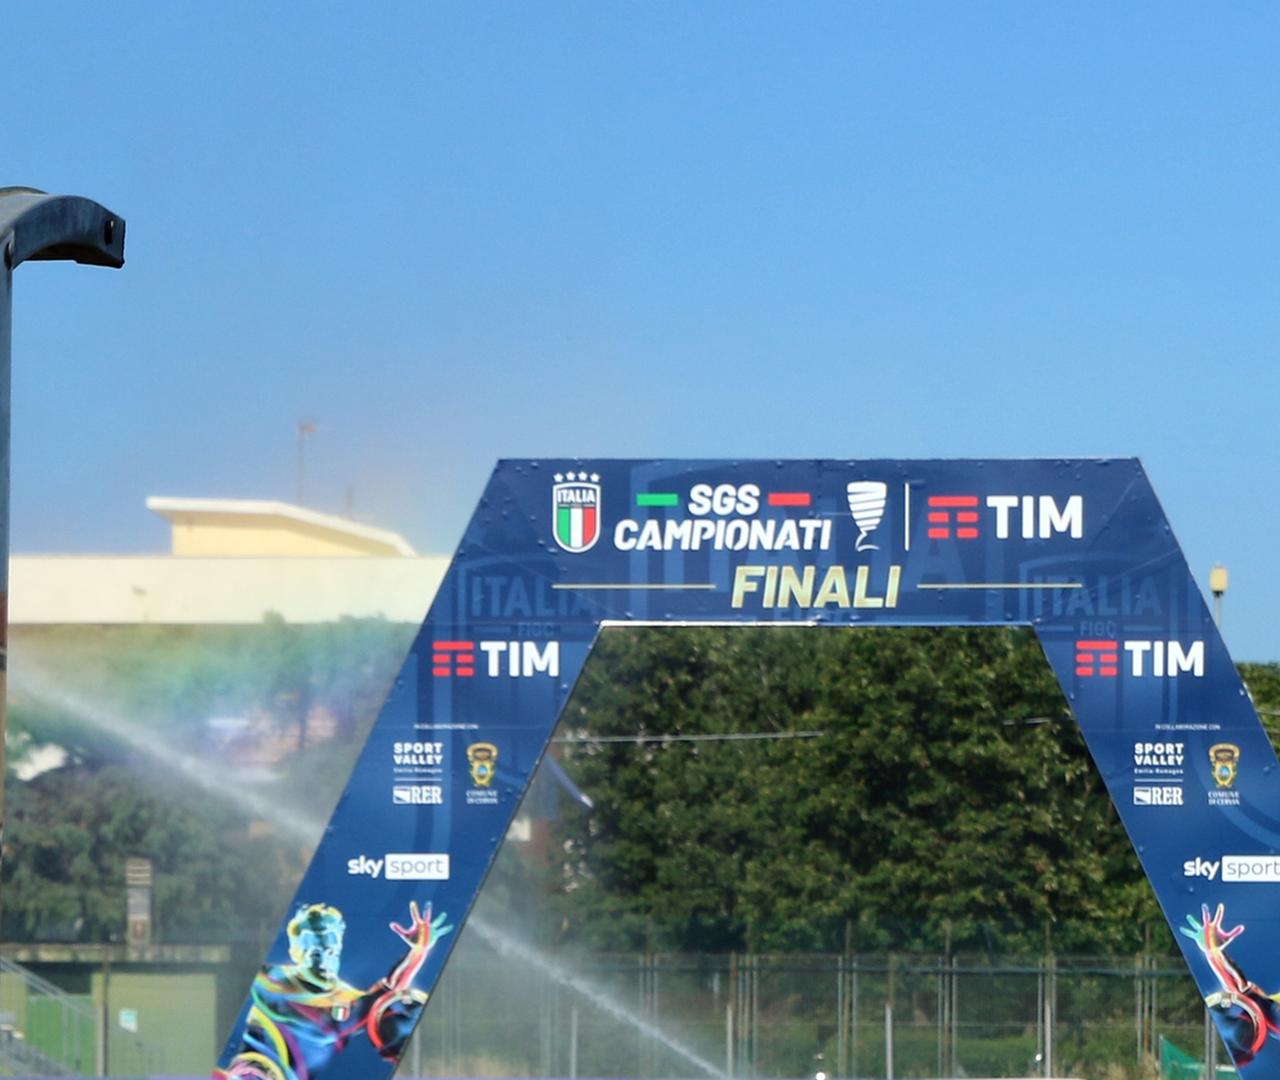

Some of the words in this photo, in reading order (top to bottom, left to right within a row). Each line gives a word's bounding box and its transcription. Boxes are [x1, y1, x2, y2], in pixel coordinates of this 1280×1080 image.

[557, 488, 596, 504] ITALIA
[688, 483, 761, 516] SGS
[986, 495, 1084, 539] TIM
[613, 518, 832, 551] CAMPIONATI
[731, 565, 902, 609] FINALI
[480, 641, 560, 677] TIM
[1124, 641, 1205, 678] TIM
[393, 742, 443, 754] SPORT
[1134, 743, 1184, 755] SPORT
[393, 755, 443, 765] VALLEY
[1134, 755, 1184, 765] VALLEY
[410, 786, 443, 804] RER
[1151, 787, 1184, 805] RER
[347, 855, 384, 879] sky
[390, 859, 444, 876] sport
[1183, 857, 1220, 880] sky
[1227, 861, 1280, 879] sport
